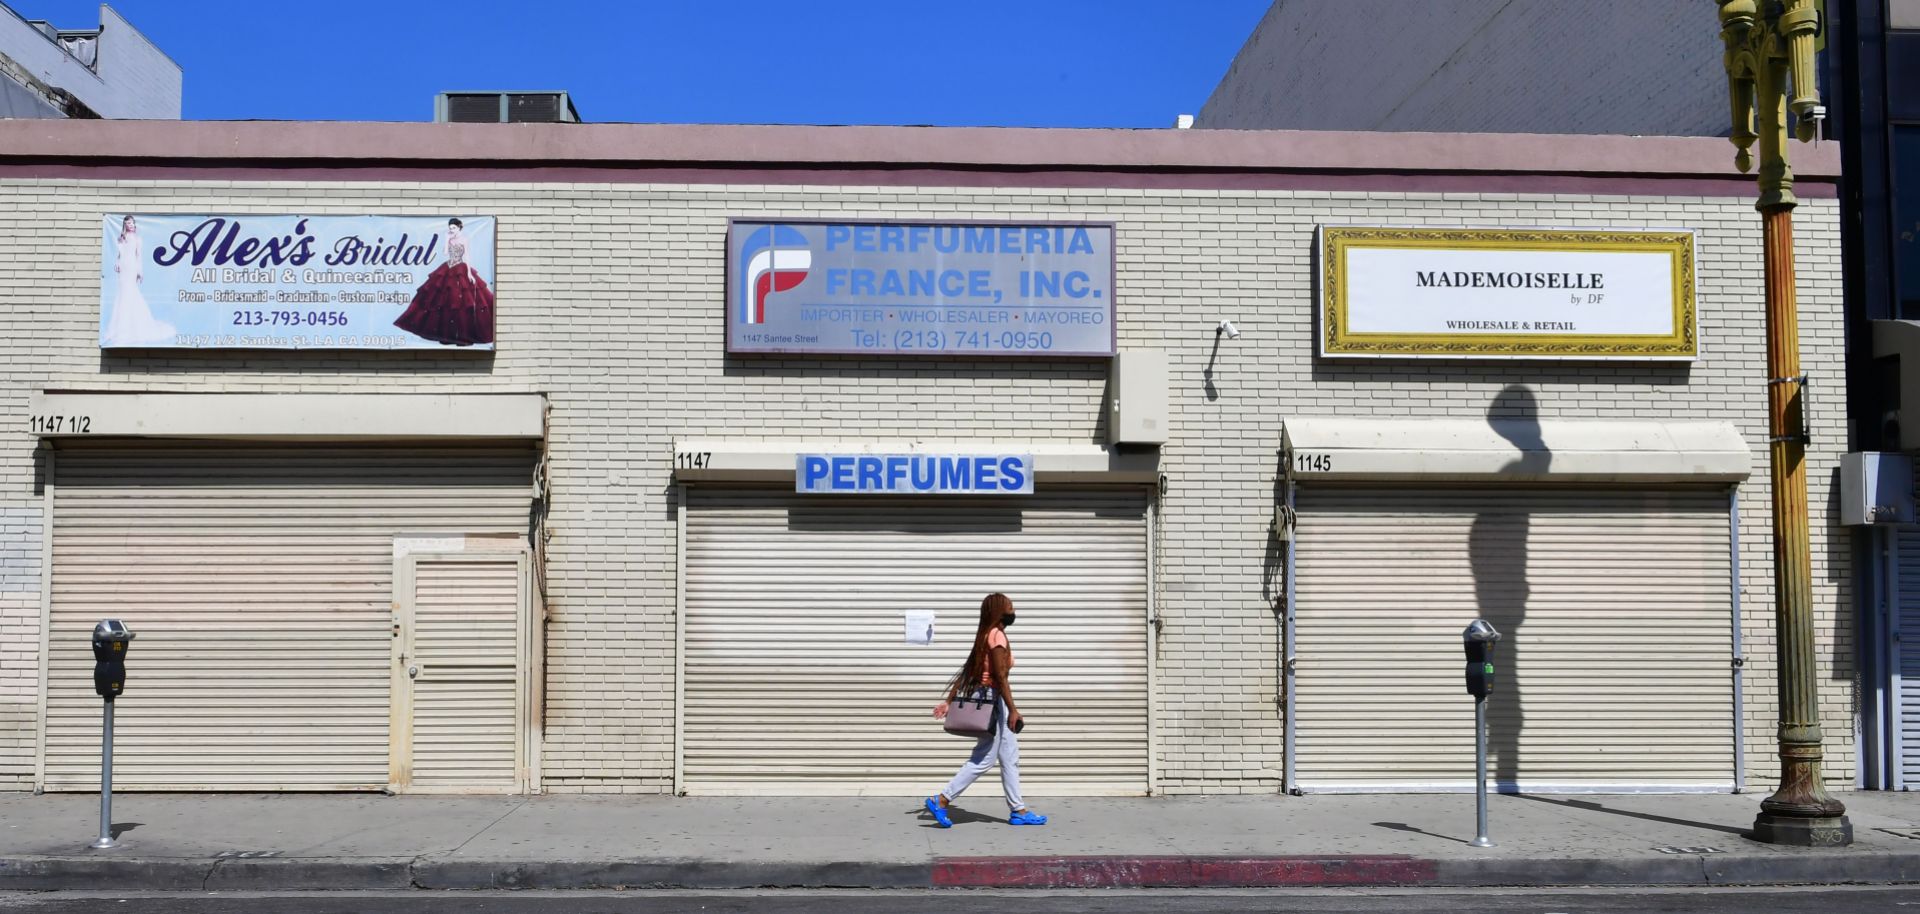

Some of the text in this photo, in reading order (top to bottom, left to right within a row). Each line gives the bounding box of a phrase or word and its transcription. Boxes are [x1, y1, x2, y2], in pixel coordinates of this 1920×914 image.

[152, 217, 439, 268] Alex's Bridal
[825, 223, 1095, 255] PERFUMERIA
[191, 267, 414, 284] All Bridal & Quinceañera
[1415, 270, 1605, 290] MADEMOISELLE
[825, 269, 1103, 304] FRANCE, INC.
[178, 289, 206, 303] Prom
[213, 289, 269, 303] Bridesmaid
[276, 290, 330, 303] Graduation
[337, 290, 376, 303] Custom
[377, 290, 411, 305] Design
[1570, 293, 1605, 306] by DF
[232, 310, 349, 327] 213-793-0456
[800, 309, 1104, 326] IMPORTER WHOLESALER MAYOREO
[1446, 320, 1576, 332] WHOLESALE & RETAIL
[176, 334, 210, 346] 1147
[214, 334, 236, 346] 1/2
[240, 334, 288, 346] Santee
[314, 335, 334, 346] LA
[338, 335, 359, 346] CA
[362, 335, 406, 346] 90015
[742, 333, 818, 344] 1147 Santee Street
[851, 328, 1053, 351] Tel: (213) 741-0950
[30, 415, 91, 433] 1147 1/2
[677, 452, 712, 470] 1147
[1297, 454, 1331, 472] 1145
[804, 456, 1026, 491] PERFUMES
